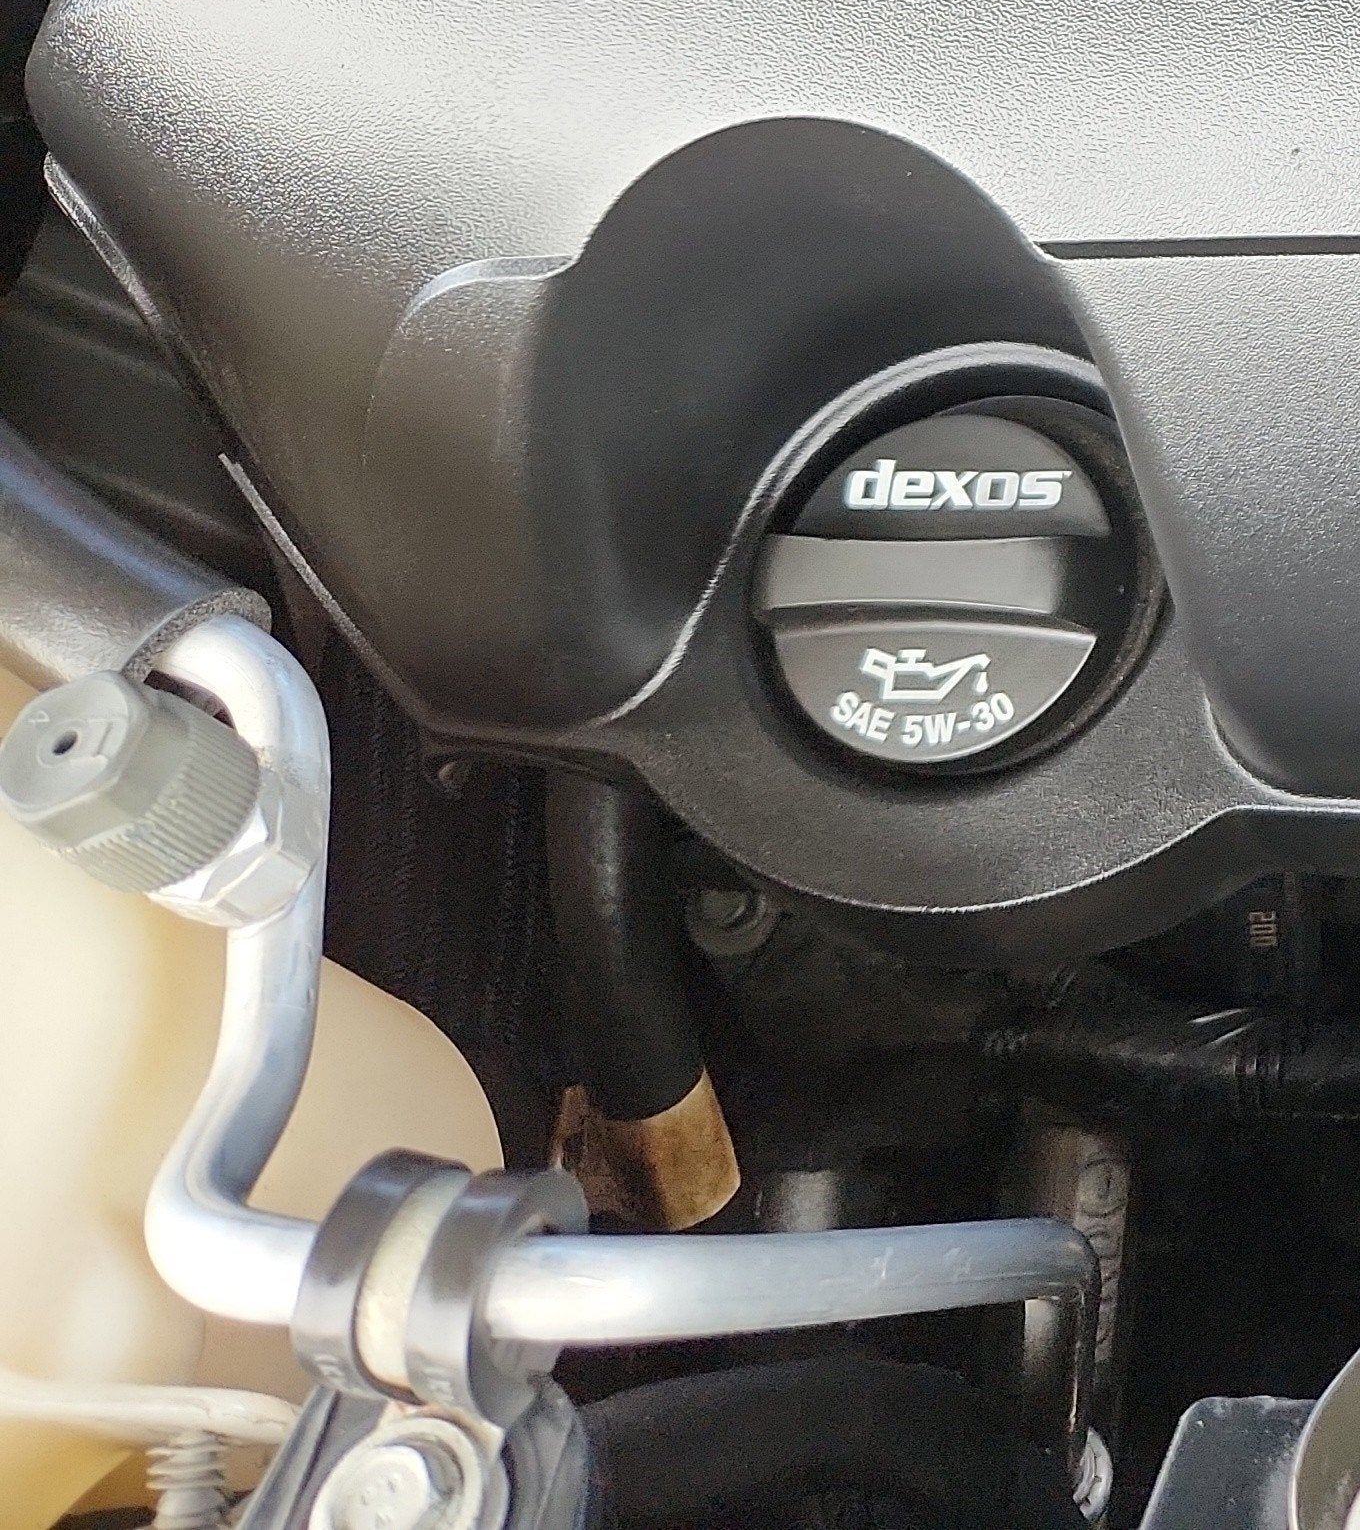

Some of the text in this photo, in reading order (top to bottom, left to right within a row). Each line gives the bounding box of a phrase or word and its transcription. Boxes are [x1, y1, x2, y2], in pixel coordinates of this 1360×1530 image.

[845, 458, 1066, 510] dexos
[830, 691, 1015, 747] SAE 5W-30
